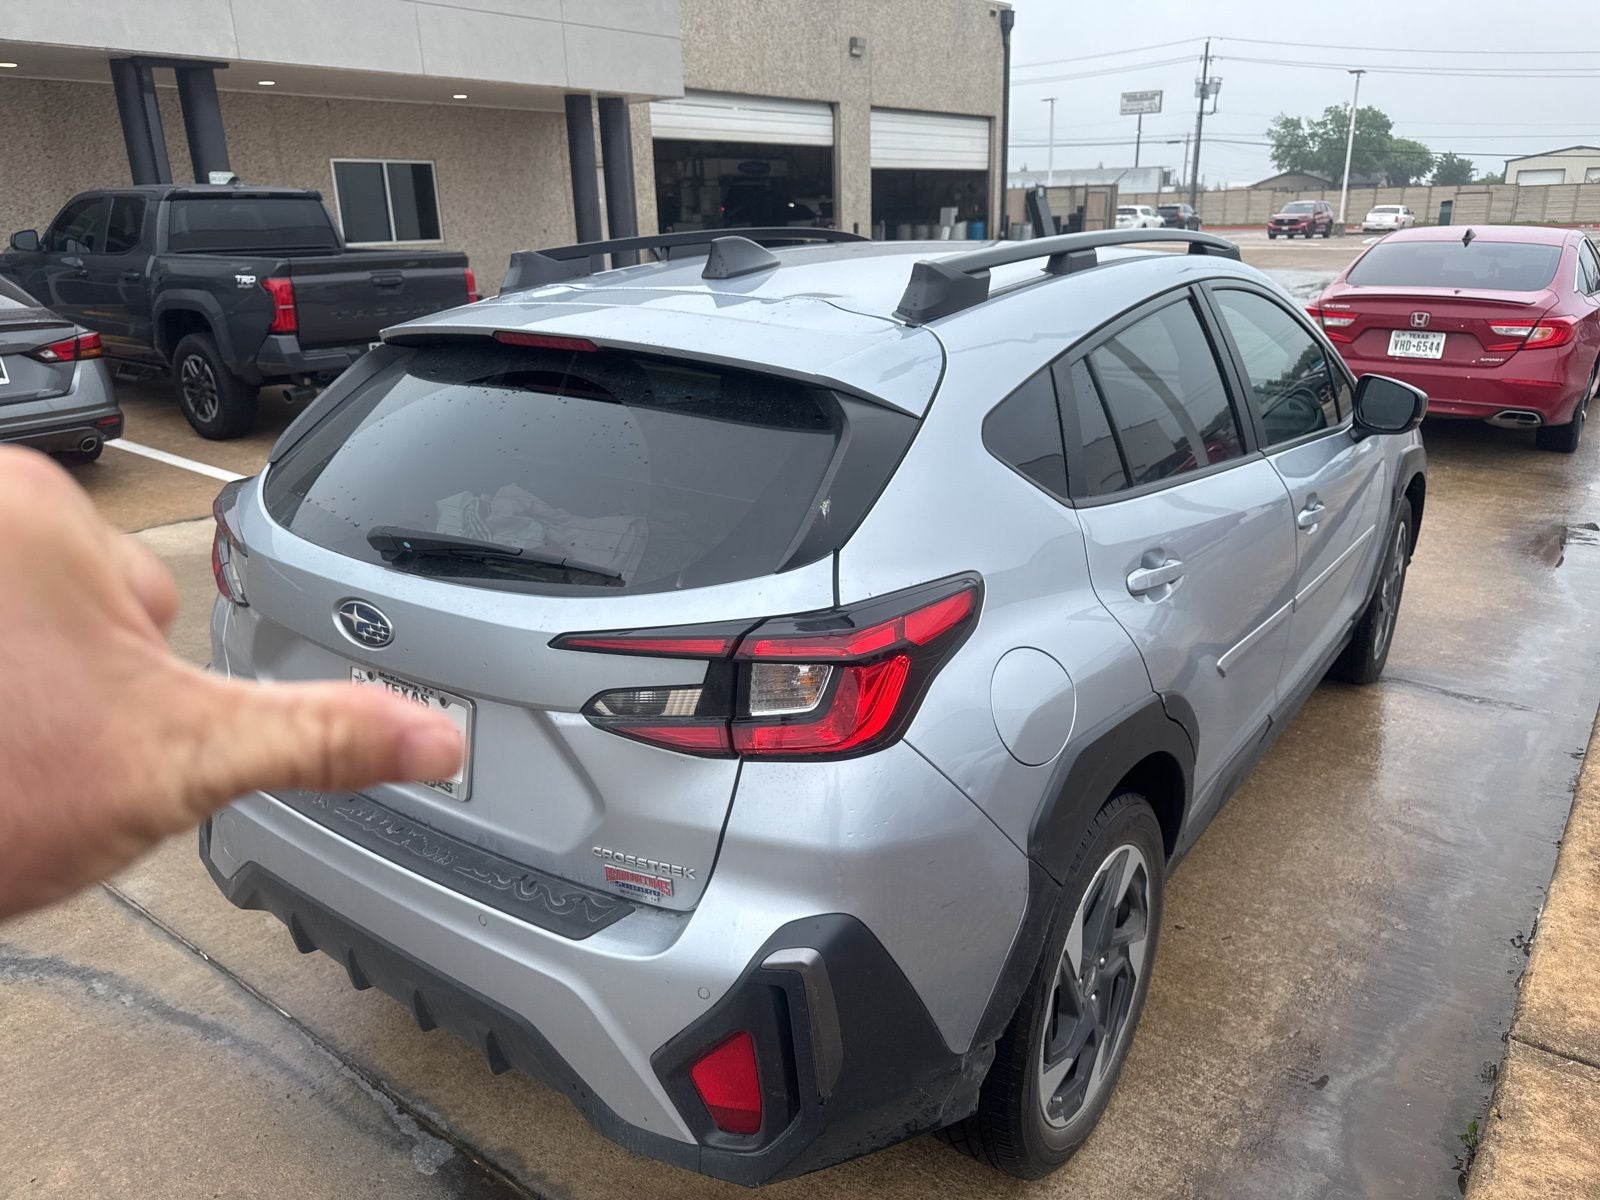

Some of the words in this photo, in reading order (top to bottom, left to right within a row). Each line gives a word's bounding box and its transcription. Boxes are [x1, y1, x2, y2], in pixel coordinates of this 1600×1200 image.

[234, 274, 256, 284] TRD
[382, 680, 430, 706] TEXAS
[592, 846, 696, 880] CROSSTREK
[614, 881, 662, 897] SUBARU
